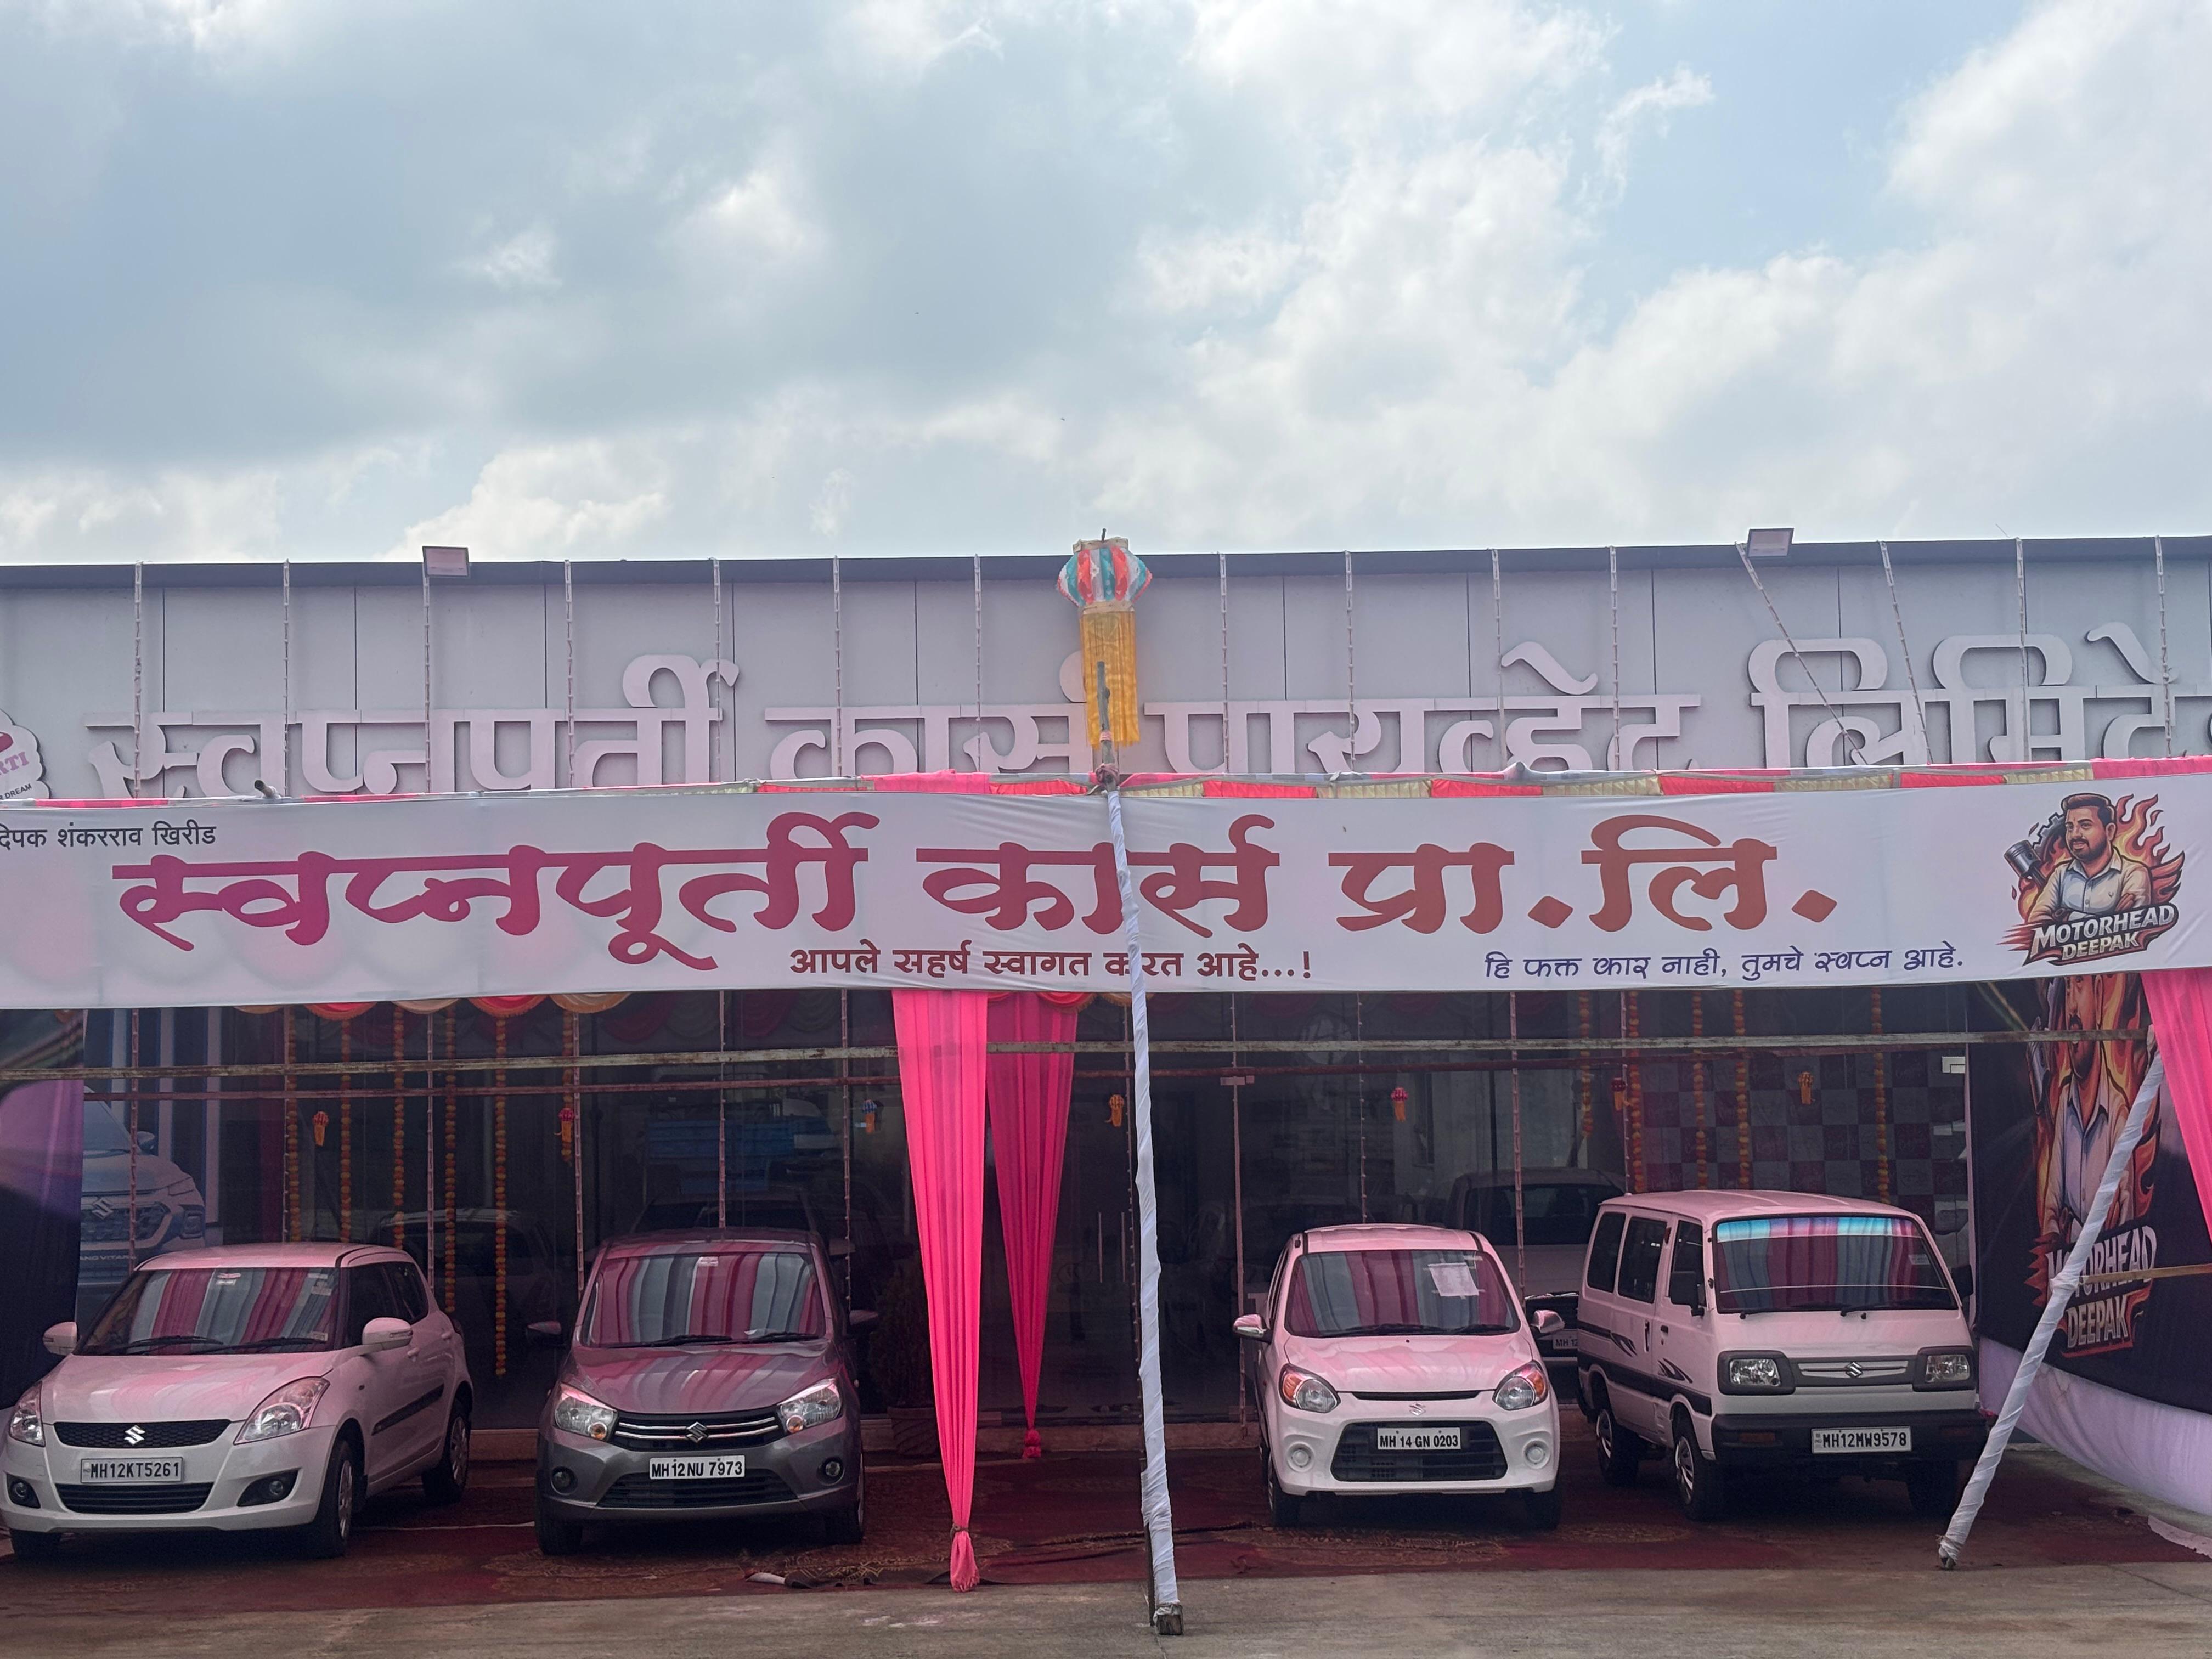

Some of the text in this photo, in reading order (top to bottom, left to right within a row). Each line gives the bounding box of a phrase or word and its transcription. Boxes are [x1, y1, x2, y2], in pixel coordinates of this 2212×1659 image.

[1748, 621, 2212, 767] लिमिटे
[4, 783, 32, 799] DREAM
[57, 822, 143, 847] शंकरराव
[151, 819, 217, 845] खिरीड
[112, 811, 880, 970] स्वप्नपूर्ती
[916, 814, 1280, 937] कार्स
[2030, 905, 2175, 958] MOTORHEAD
[789, 939, 881, 973] आपले
[892, 939, 972, 978] सहर्ष
[983, 951, 1092, 975] स्वागत
[1103, 952, 1184, 977] करत
[1485, 940, 1963, 981] हि फक्त कार नाही, तुमचे स्वप्न आहे.
[2062, 932, 2140, 961] DEEPAK
[2066, 1294, 2129, 1348] DEEPAK
[1555, 1339, 1568, 1347] MH
[1380, 1435, 1458, 1448] MH 14 GN 0203
[1822, 1432, 1907, 1448] MH12MW9578
[91, 1462, 179, 1478] MH12KT5261
[652, 1461, 743, 1477] MH 12 NU 7973
